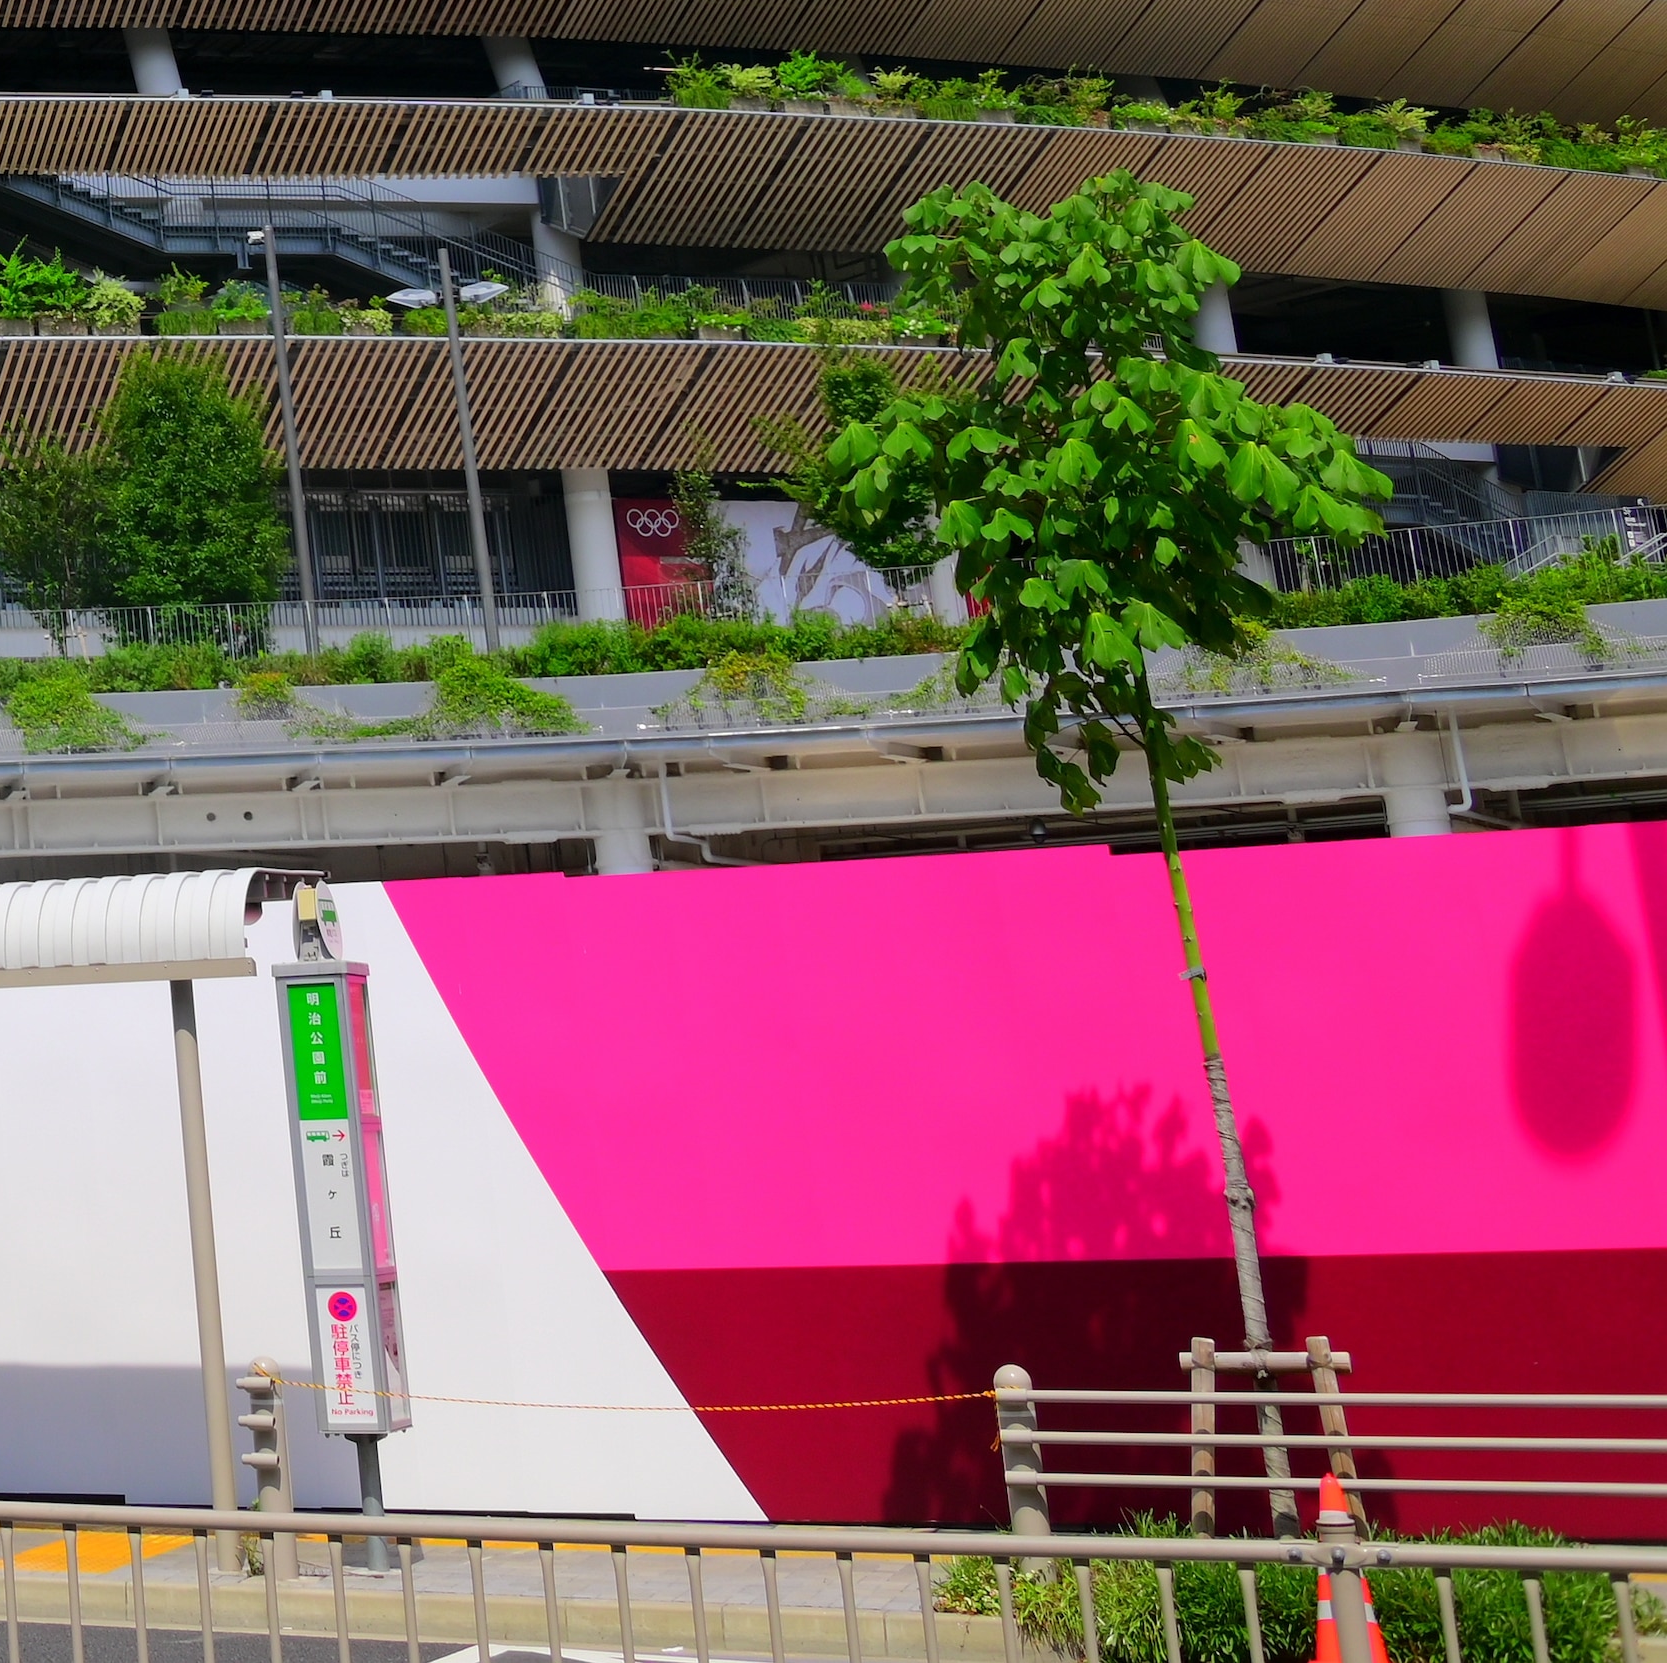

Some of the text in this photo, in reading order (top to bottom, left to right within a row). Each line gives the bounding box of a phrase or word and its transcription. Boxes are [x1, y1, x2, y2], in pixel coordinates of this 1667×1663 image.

[306, 992, 327, 1084] 明治公園前
[339, 1153, 349, 1177] つぎは
[331, 1323, 354, 1405] 駐停車禁止
[349, 1324, 362, 1379] バス停につき
[344, 1408, 374, 1417] Parking
